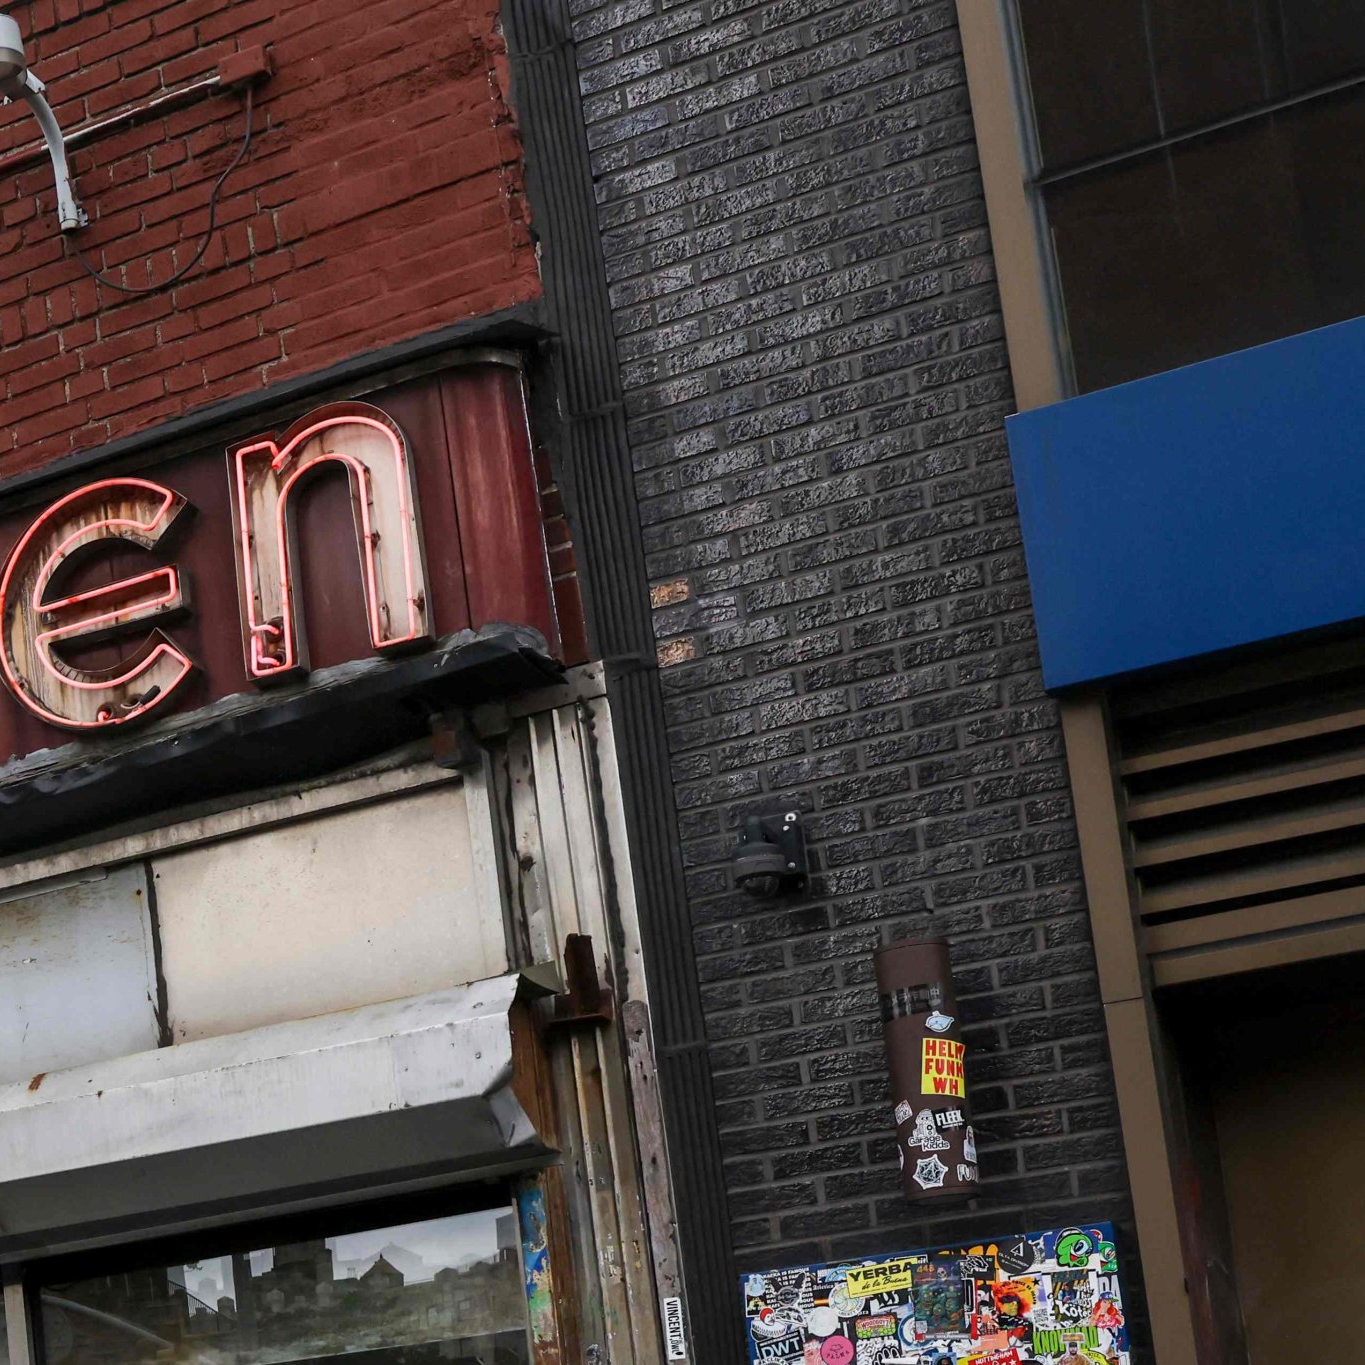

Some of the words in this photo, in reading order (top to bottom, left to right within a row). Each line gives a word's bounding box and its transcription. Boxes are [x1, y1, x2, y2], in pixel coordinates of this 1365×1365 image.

[933, 1077, 959, 1095] WH
[909, 1134, 941, 1145] Garage
[922, 1140, 949, 1150] Kidds
[848, 1261, 912, 1282] YERBA
[760, 1337, 800, 1359] DWT
[975, 1350, 1013, 1365] NOTTINGHAM
